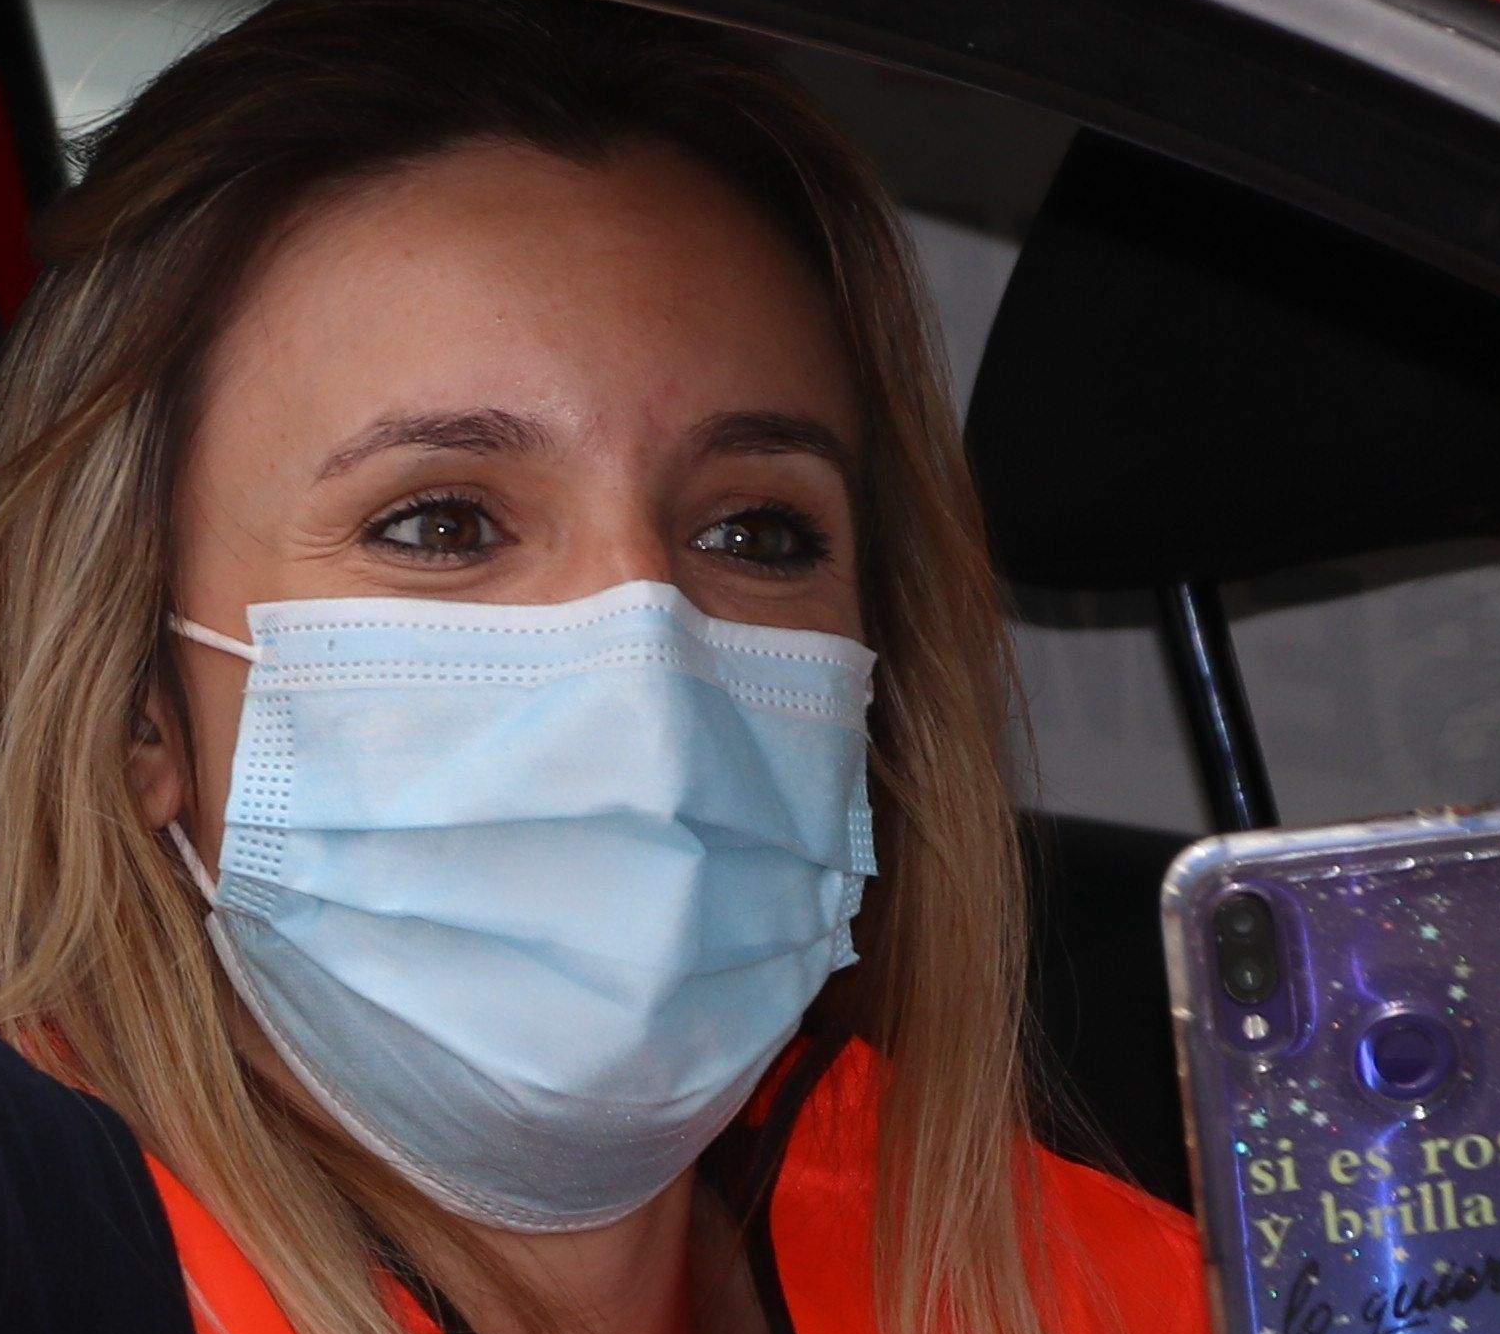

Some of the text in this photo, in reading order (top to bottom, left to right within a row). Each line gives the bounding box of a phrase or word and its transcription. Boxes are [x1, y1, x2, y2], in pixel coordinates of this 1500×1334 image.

[1250, 1137, 1301, 1195] si
[1328, 1146, 1395, 1185] es
[1255, 1179, 1499, 1268] y brilla
